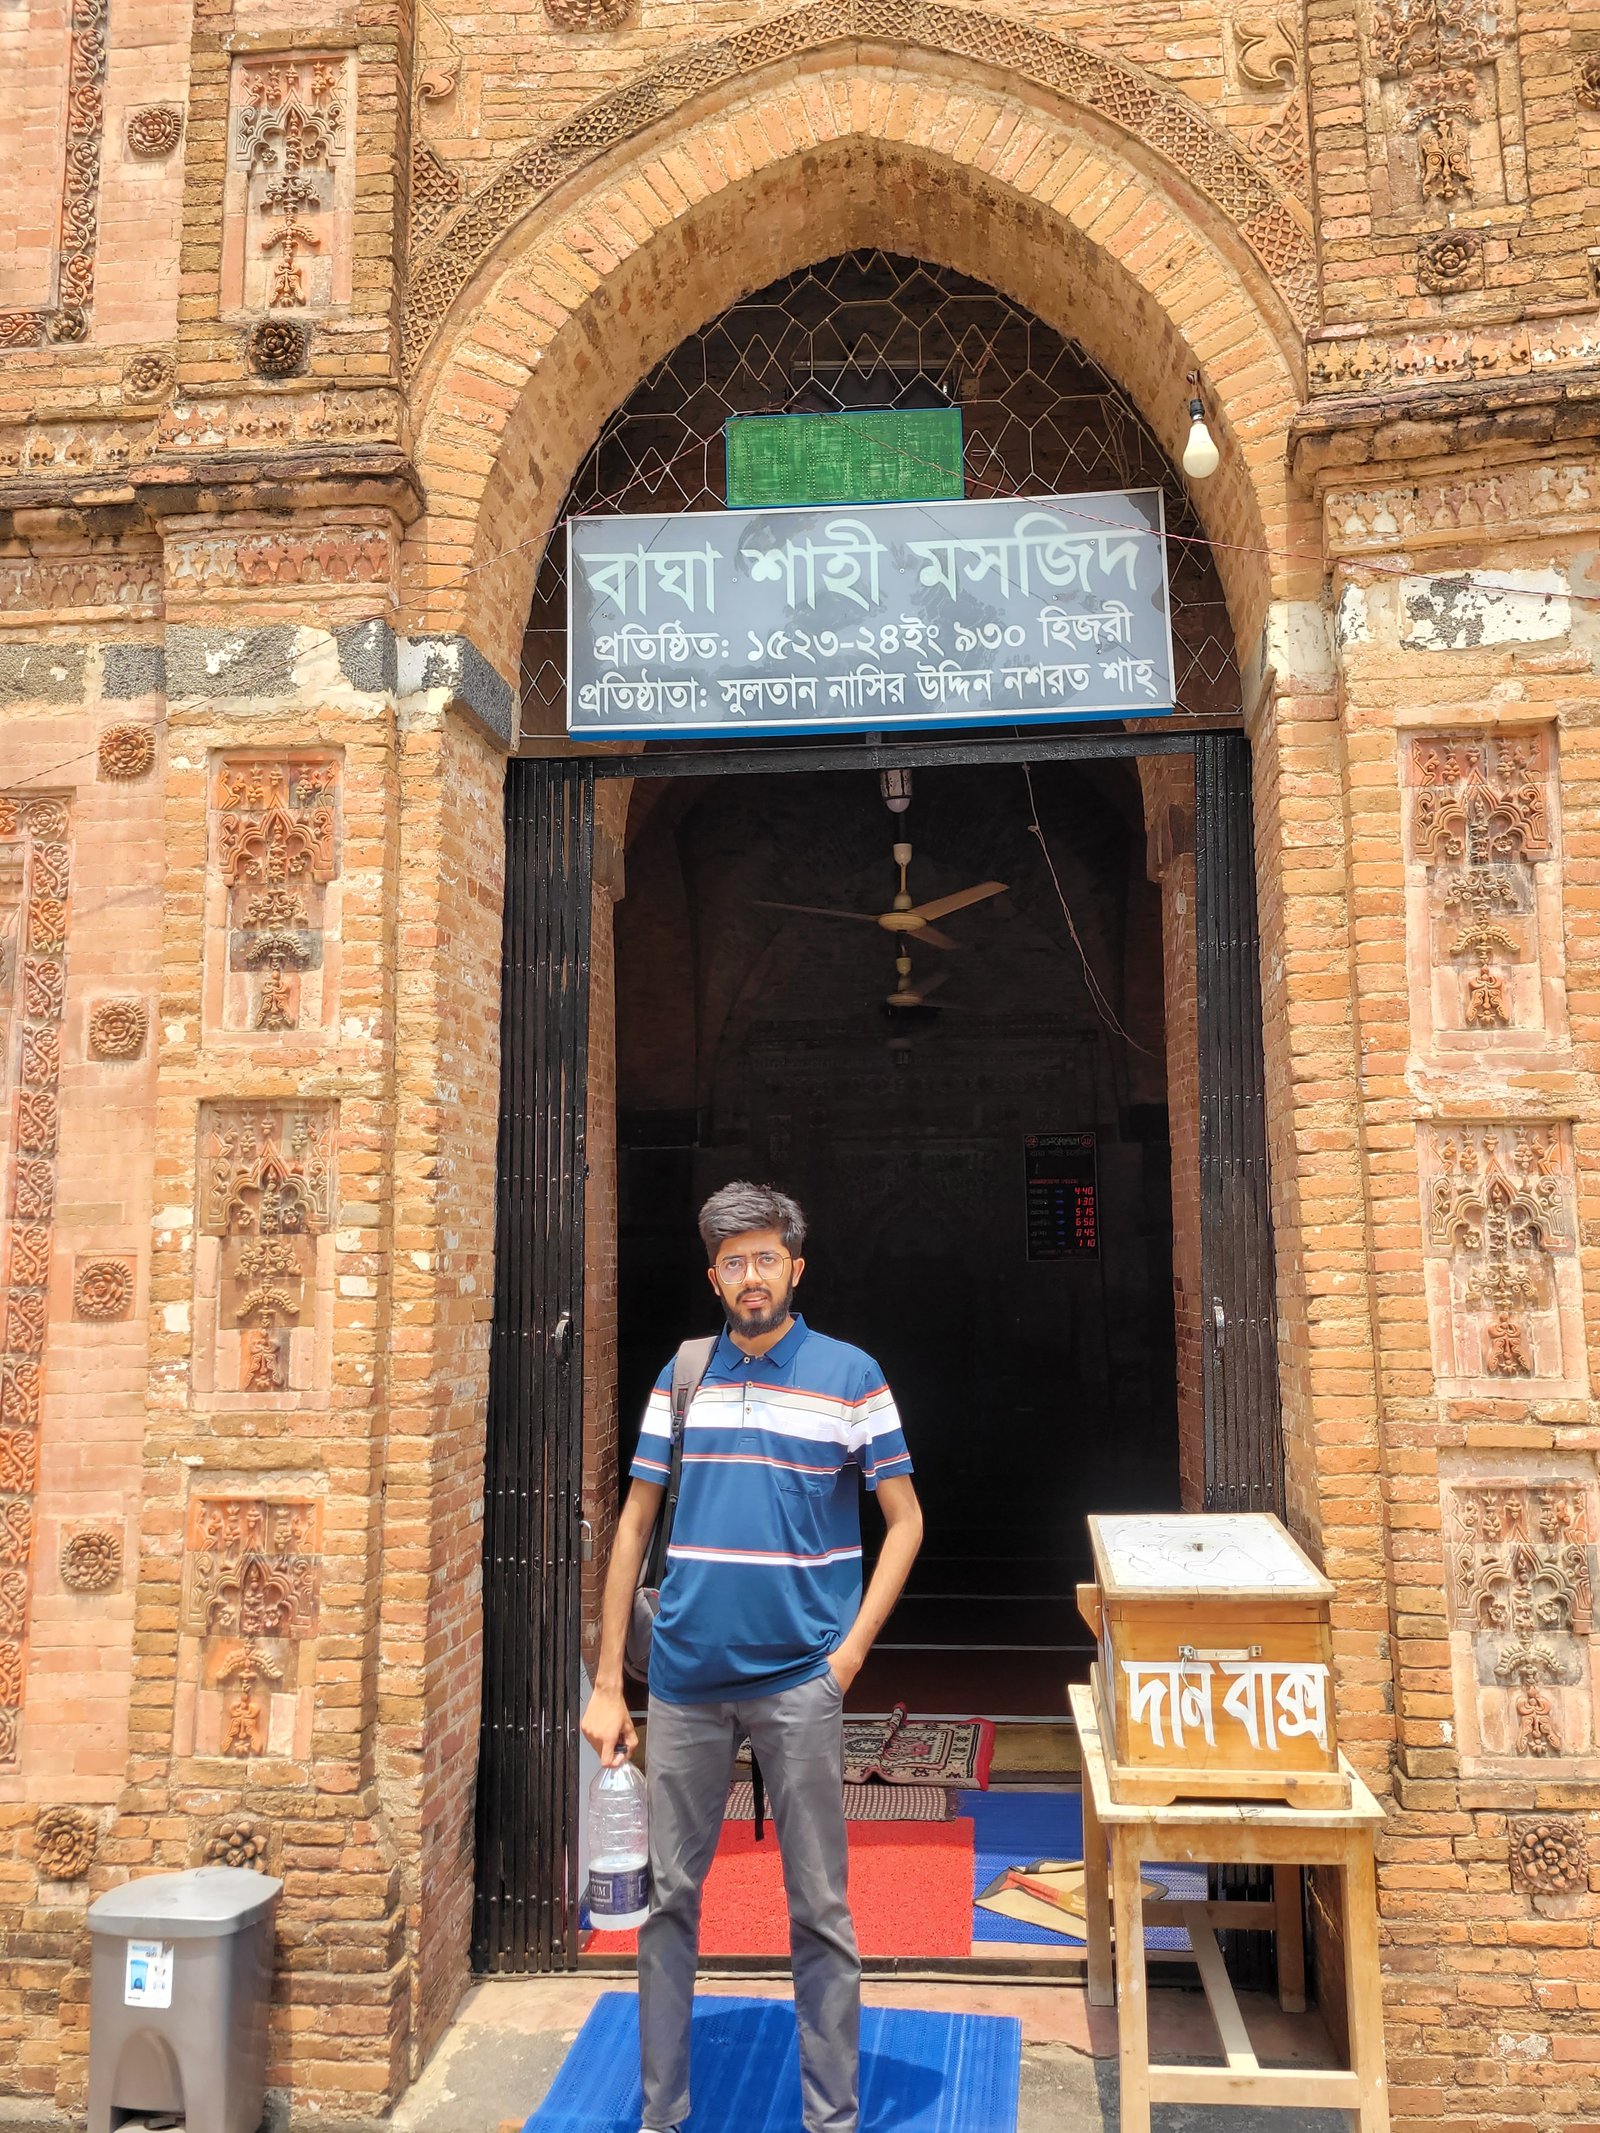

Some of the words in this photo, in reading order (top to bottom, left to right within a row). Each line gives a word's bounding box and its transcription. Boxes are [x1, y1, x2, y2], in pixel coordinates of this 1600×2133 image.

[579, 541, 724, 616] বাঘা
[740, 518, 888, 611] শাহী
[906, 511, 1147, 603] মসজিদ
[594, 620, 730, 668] প্রতিষ্ঠিত:
[747, 614, 944, 663] ১৫২৩-২৪ইং
[953, 622, 1025, 652] ৯৩০
[1037, 600, 1134, 650] হিজরী
[578, 668, 707, 717] প্রতিষ্ঠাতা:
[718, 674, 819, 716] সুলতান
[825, 663, 907, 708] নাসির
[914, 659, 993, 703] উদ্দিন
[1001, 662, 1090, 699] নশরত
[1099, 656, 1159, 697] শাহ্
[1121, 1661, 1217, 1749] দান
[1219, 1661, 1333, 1753] বাক্স
